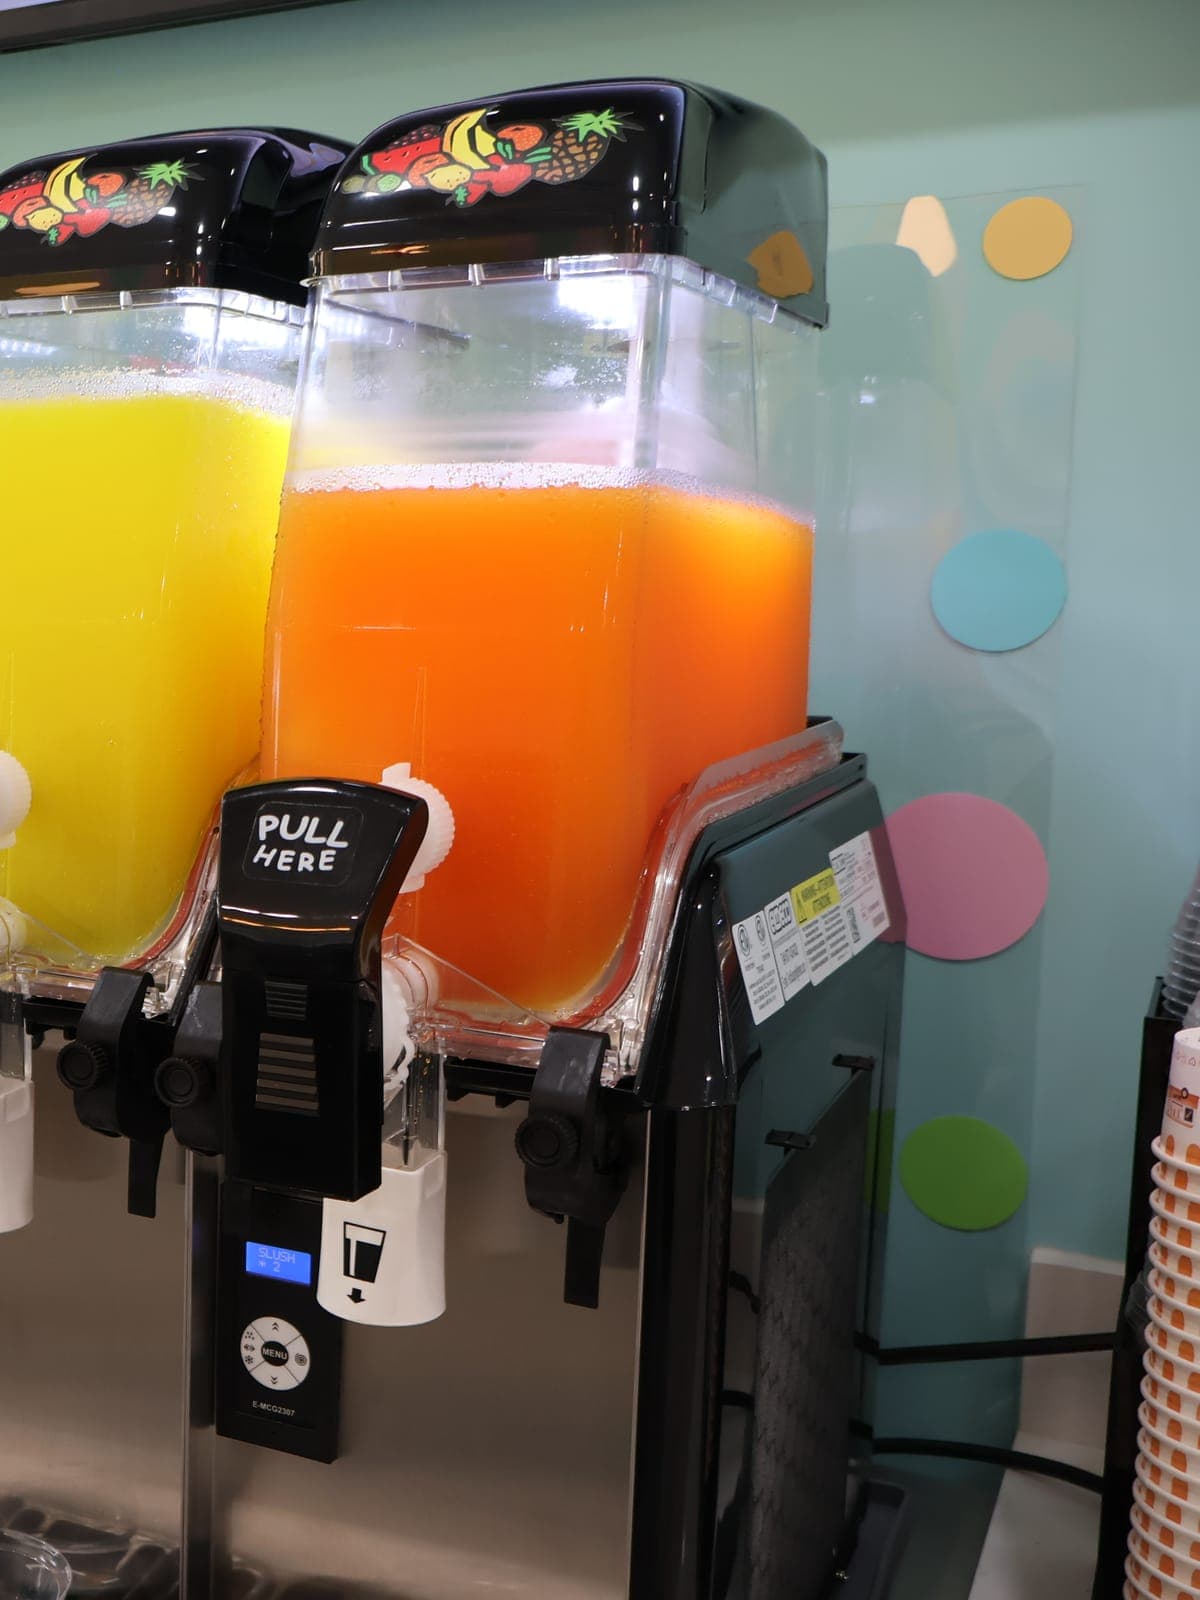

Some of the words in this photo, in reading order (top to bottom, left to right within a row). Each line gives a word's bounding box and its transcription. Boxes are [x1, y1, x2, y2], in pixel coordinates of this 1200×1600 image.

[258, 814, 349, 849] PULL
[252, 844, 337, 872] HERE
[258, 1247, 296, 1264] SLUSH
[273, 1262, 281, 1272] 2
[262, 1347, 288, 1360] MENU
[252, 1400, 296, 1417] E-MCG2307
